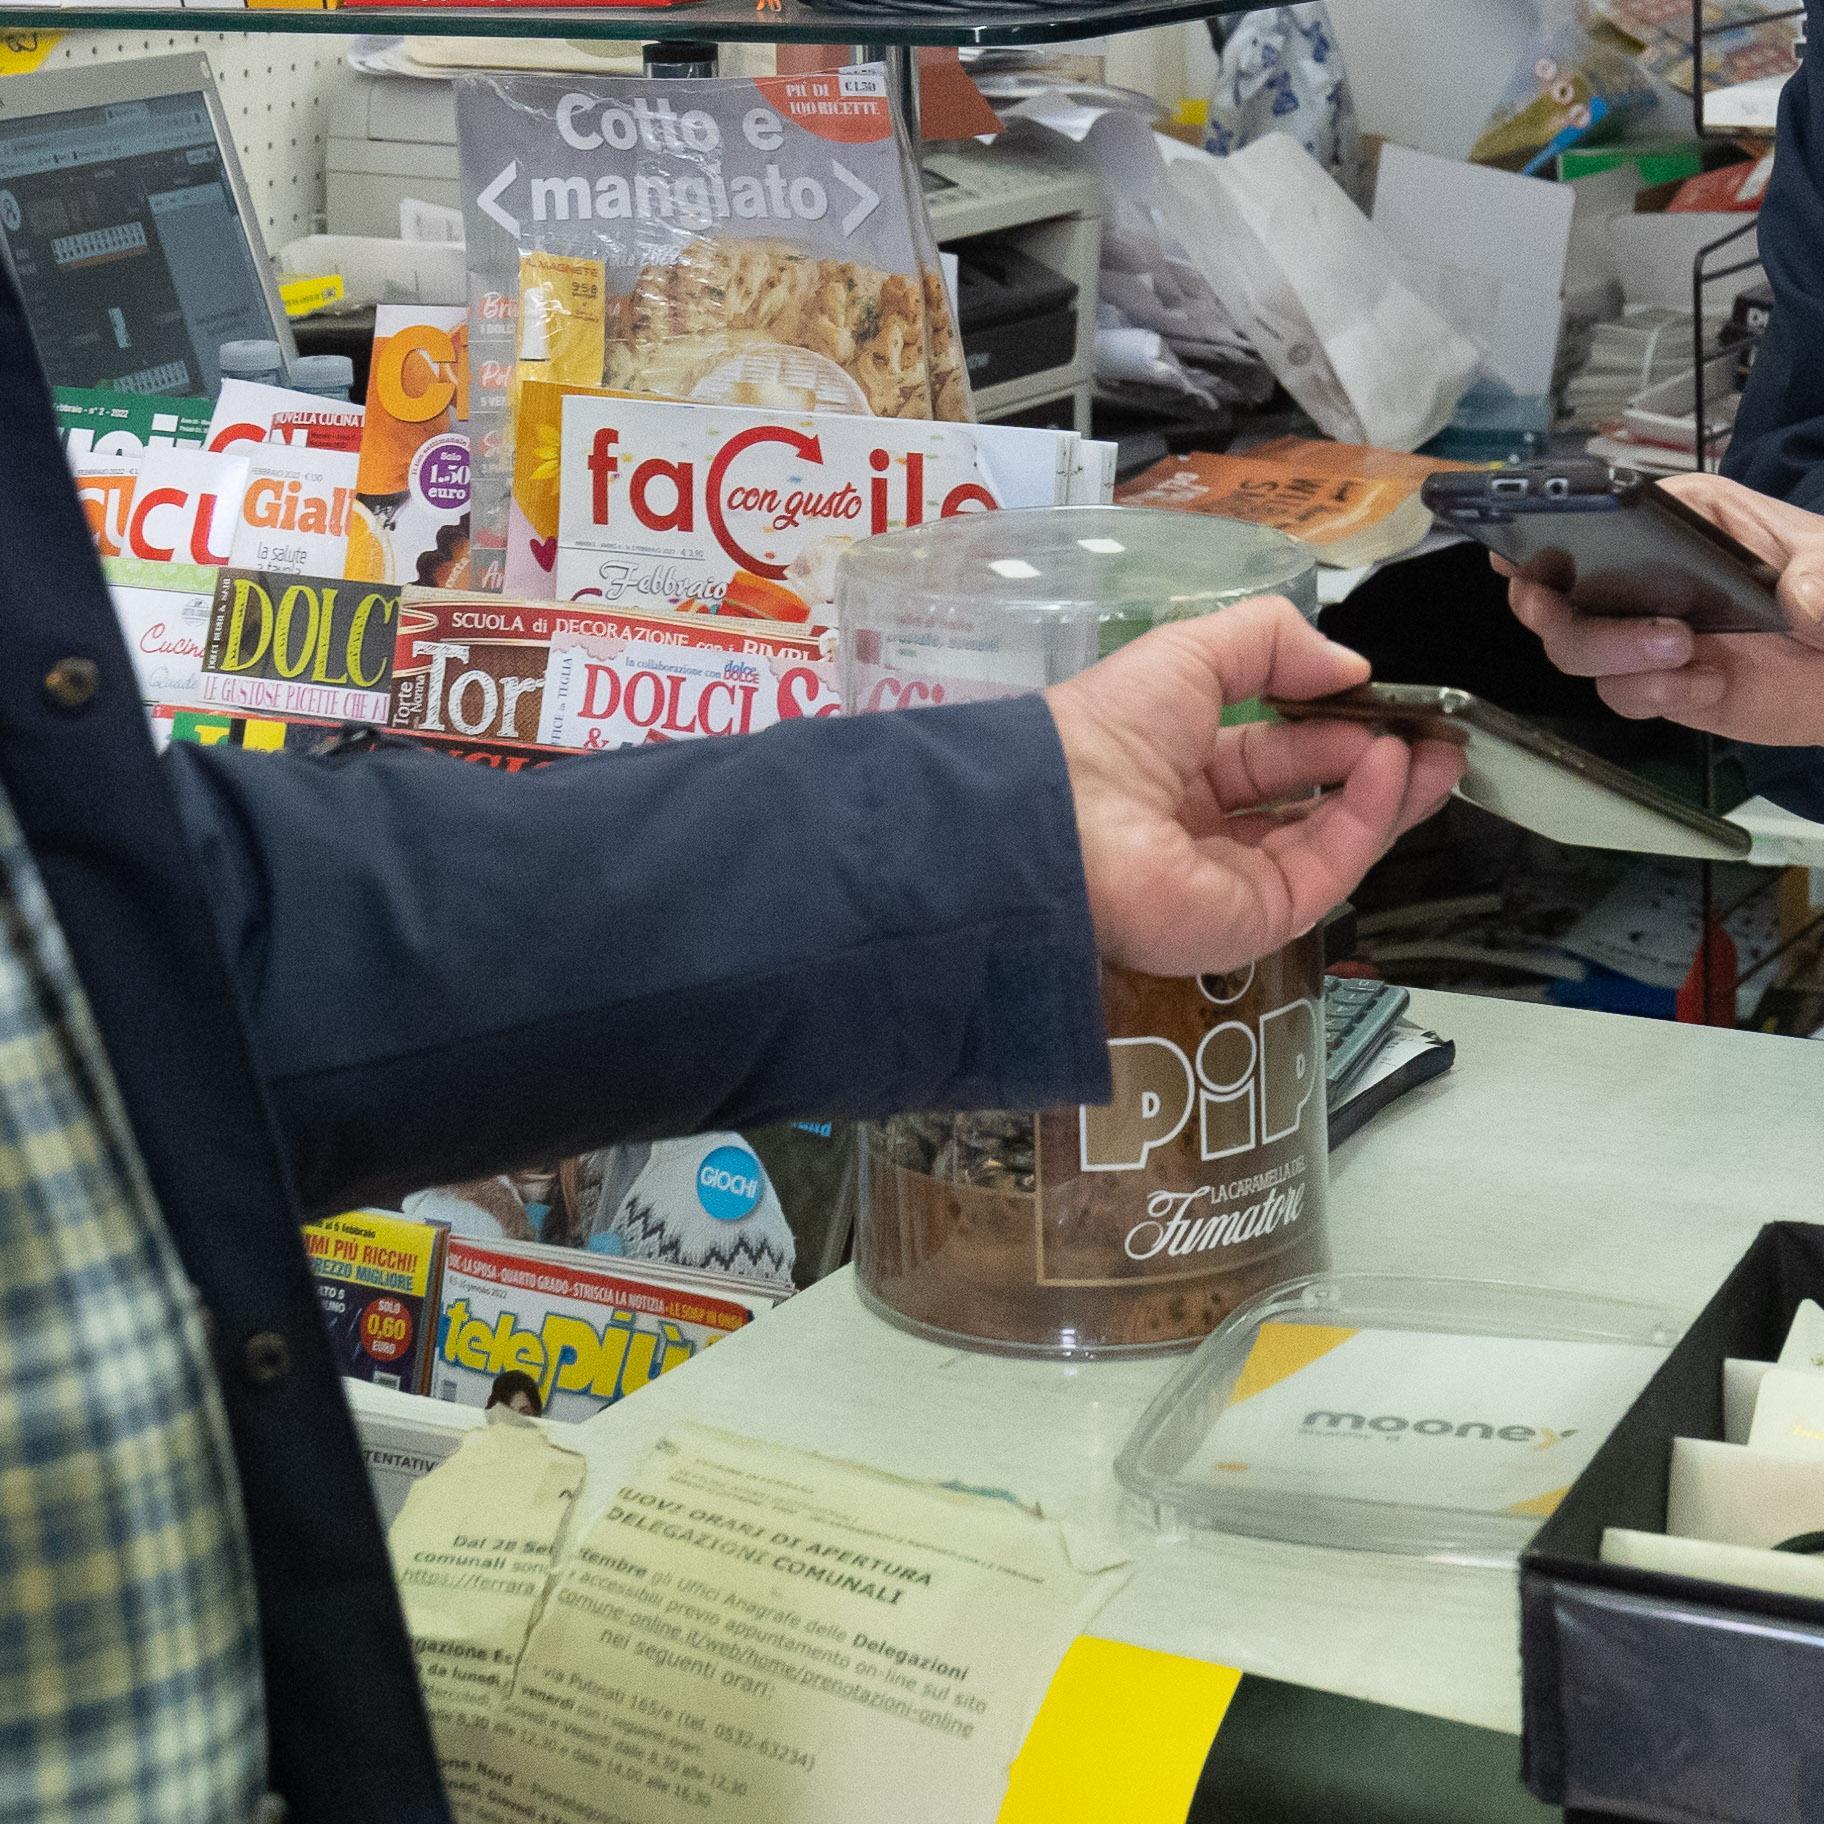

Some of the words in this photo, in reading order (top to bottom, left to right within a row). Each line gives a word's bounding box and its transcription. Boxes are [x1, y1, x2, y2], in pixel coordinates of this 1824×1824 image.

[556, 92, 721, 152] Cotto
[743, 107, 784, 151] e
[531, 164, 829, 231] mangiato
[426, 486, 466, 501] euro
[726, 480, 776, 516] con
[773, 476, 863, 532] gusto
[272, 542, 308, 567] salute
[598, 558, 728, 602] Febbraio
[452, 610, 526, 635] SCUOLA
[532, 617, 549, 636] di
[554, 616, 689, 648] DECORAZIONE
[637, 658, 702, 678] collaborazione
[393, 679, 412, 728] Torte
[577, 663, 760, 738] DOLCI
[698, 1163, 759, 1200] GIOCHI
[1124, 1182, 1306, 1261] Fumatore
[333, 1237, 359, 1261] PIÙ
[362, 1245, 418, 1273] RICCHI!
[356, 1265, 414, 1291] MIGLIORE
[366, 1314, 406, 1341] 0,60
[377, 1300, 401, 1314] SOLO
[372, 1340, 397, 1355] EURO
[1299, 1409, 1577, 1451] mooney
[688, 1506, 764, 1544] ORARI
[770, 1529, 800, 1549] DI
[805, 1540, 934, 1587] APERTURA
[771, 1558, 904, 1607] COMUNALI
[634, 1640, 717, 1682] seguenti
[852, 1631, 970, 1683] Delegazioni
